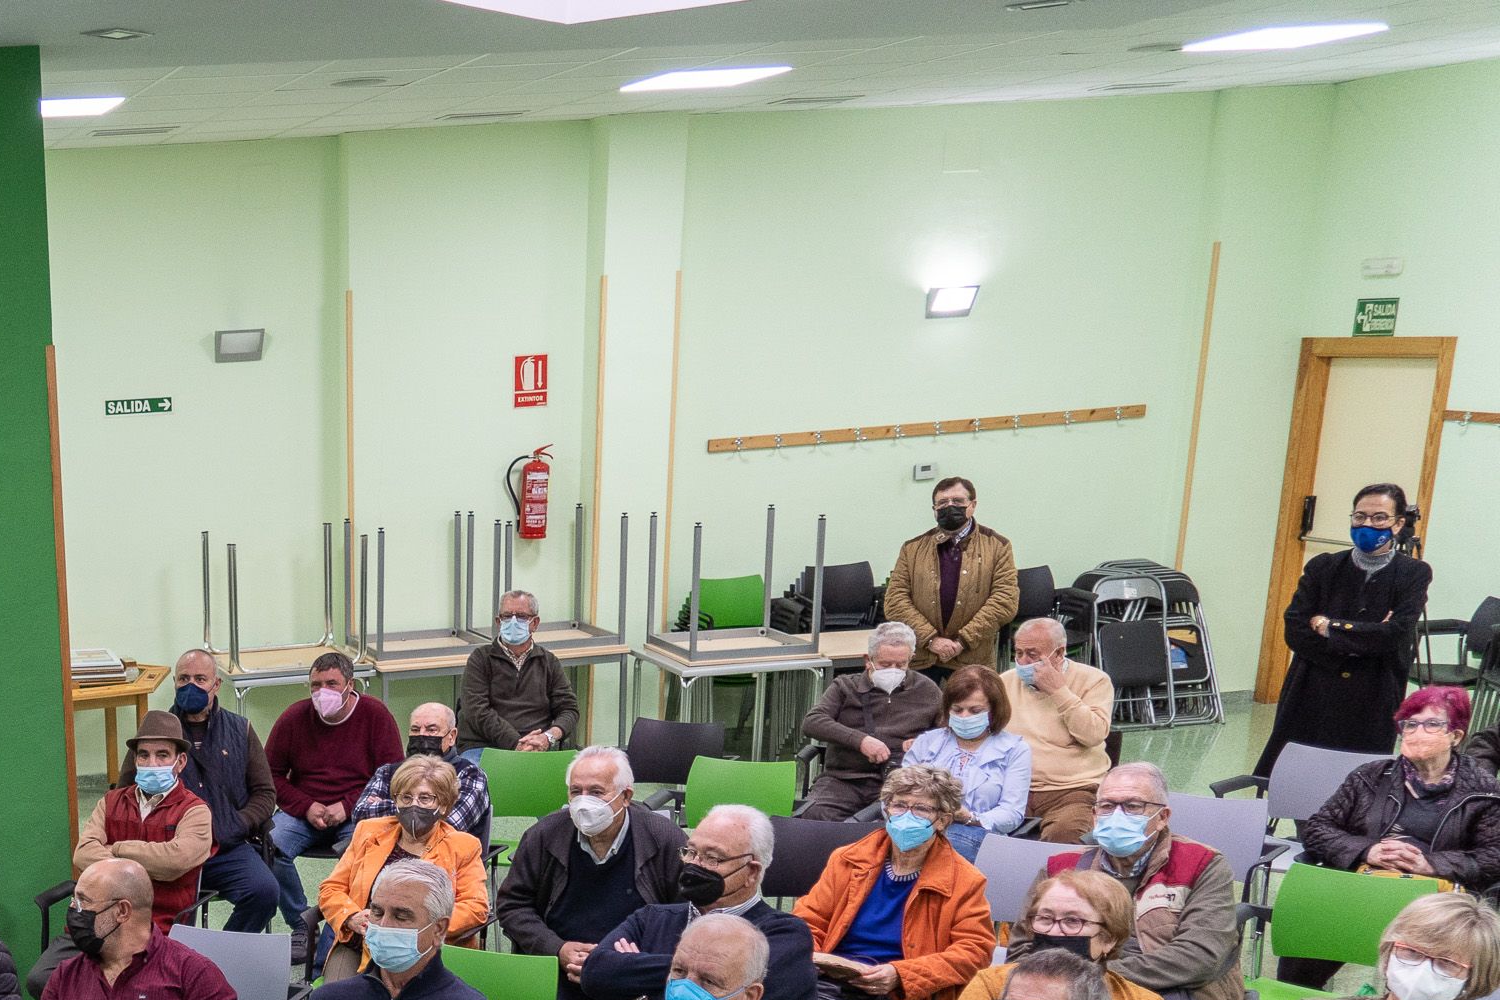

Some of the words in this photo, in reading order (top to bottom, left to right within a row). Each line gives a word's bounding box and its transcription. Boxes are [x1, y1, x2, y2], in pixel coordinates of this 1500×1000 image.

[1373, 304, 1396, 316] SALIDA
[517, 395, 544, 403] EXTINTOR
[107, 400, 152, 414] SALIDA
